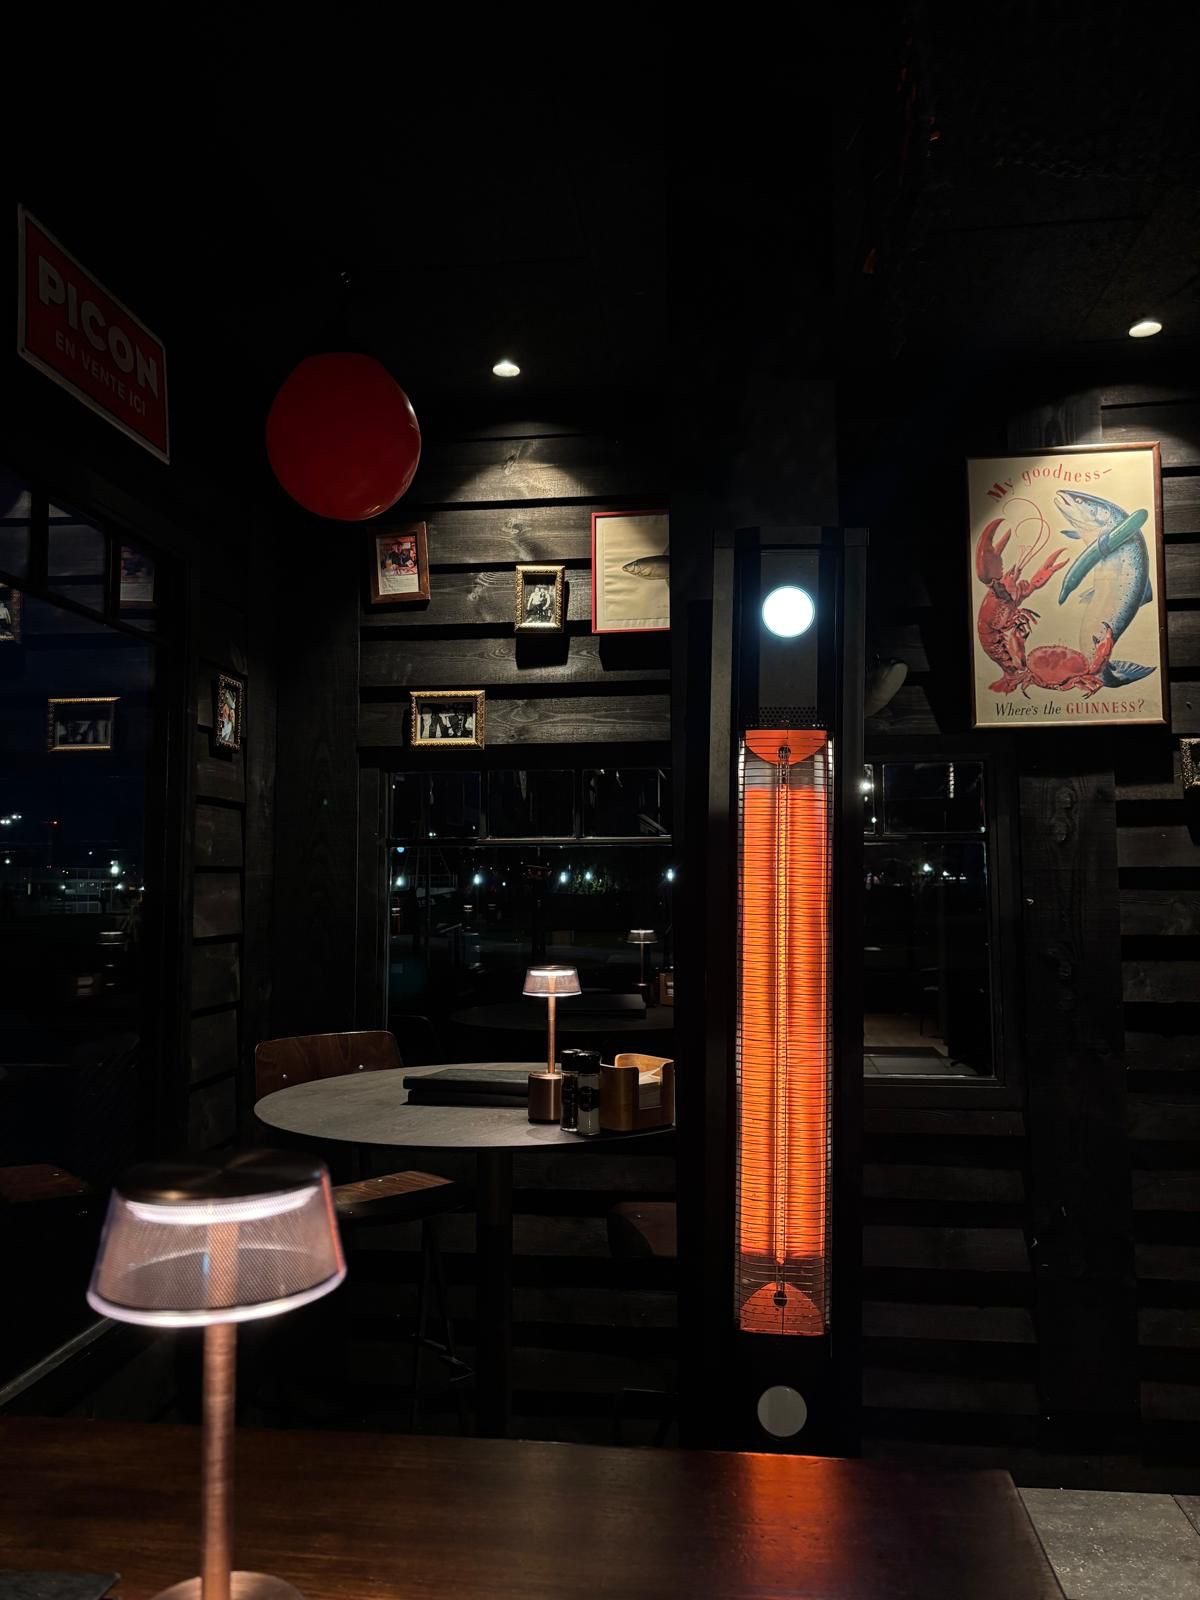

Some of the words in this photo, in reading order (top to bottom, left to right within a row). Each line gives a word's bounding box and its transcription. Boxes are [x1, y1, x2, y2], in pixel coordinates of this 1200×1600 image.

[38, 255, 159, 399] PICON
[55, 330, 75, 359] EN
[81, 354, 125, 400] VENTE
[129, 391, 146, 417] ICI
[987, 478, 1015, 503] My
[995, 702, 1038, 717] Where's
[1043, 701, 1061, 715] the
[1066, 699, 1145, 714] GUINNESS?
